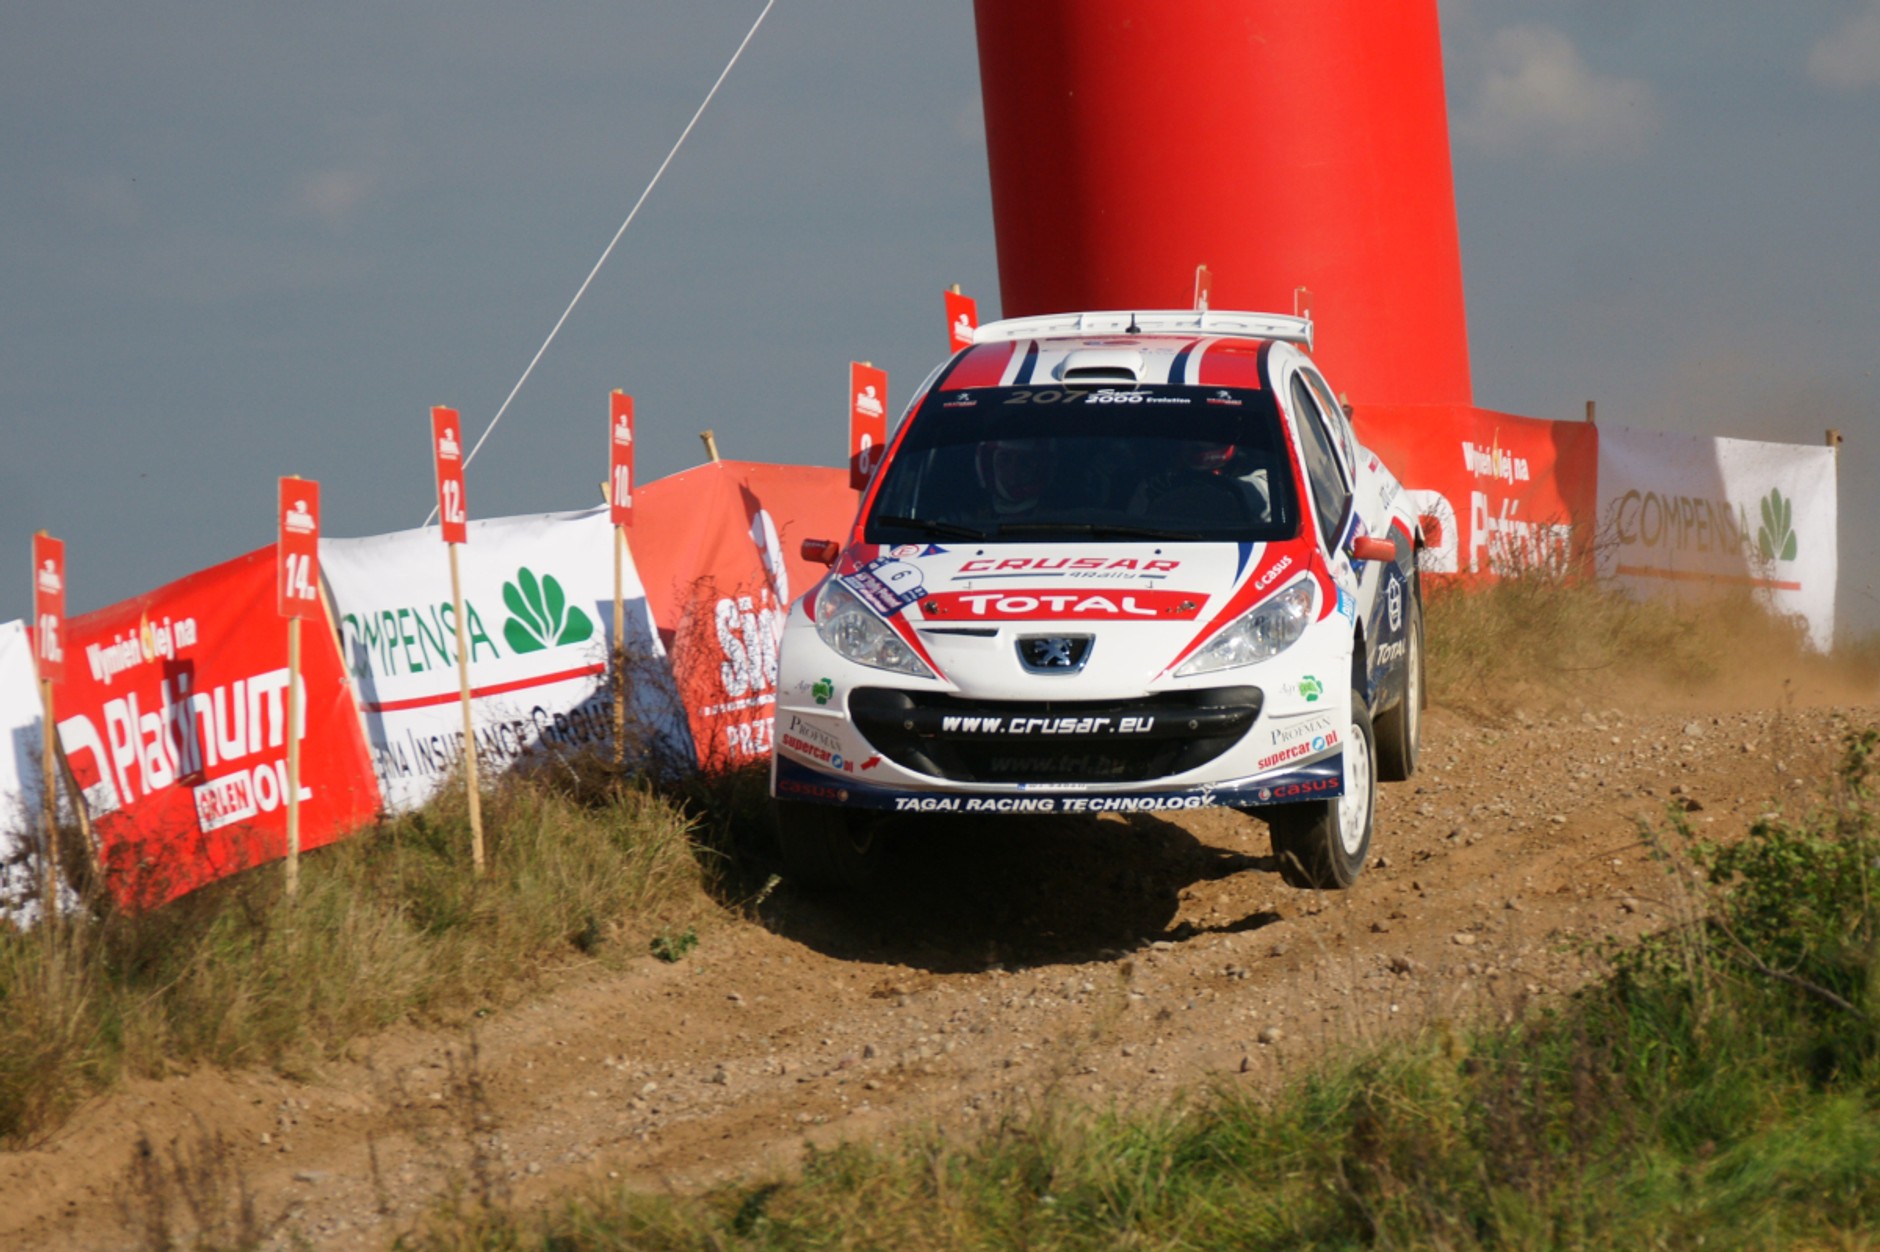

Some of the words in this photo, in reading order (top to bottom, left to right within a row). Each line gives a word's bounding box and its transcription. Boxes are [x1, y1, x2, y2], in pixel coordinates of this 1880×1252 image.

[1002, 389, 1088, 405] 207
[1084, 394, 1144, 405] 2000
[1616, 489, 1752, 556] COMPENSA
[891, 570, 912, 581] 6
[959, 558, 1181, 573] CRUSAR
[1261, 555, 1293, 585] casus
[959, 594, 1158, 615] TOTAL
[174, 617, 197, 649] na
[342, 599, 502, 680] OMPENSA
[103, 664, 307, 804] Platinum
[942, 717, 1154, 734] www.crusar.eu
[253, 759, 313, 812] OIL
[1273, 777, 1340, 797] casus
[895, 798, 960, 811] TAGAI
[966, 798, 1055, 811] RACING
[1061, 794, 1215, 811] TECHNOLOGY
